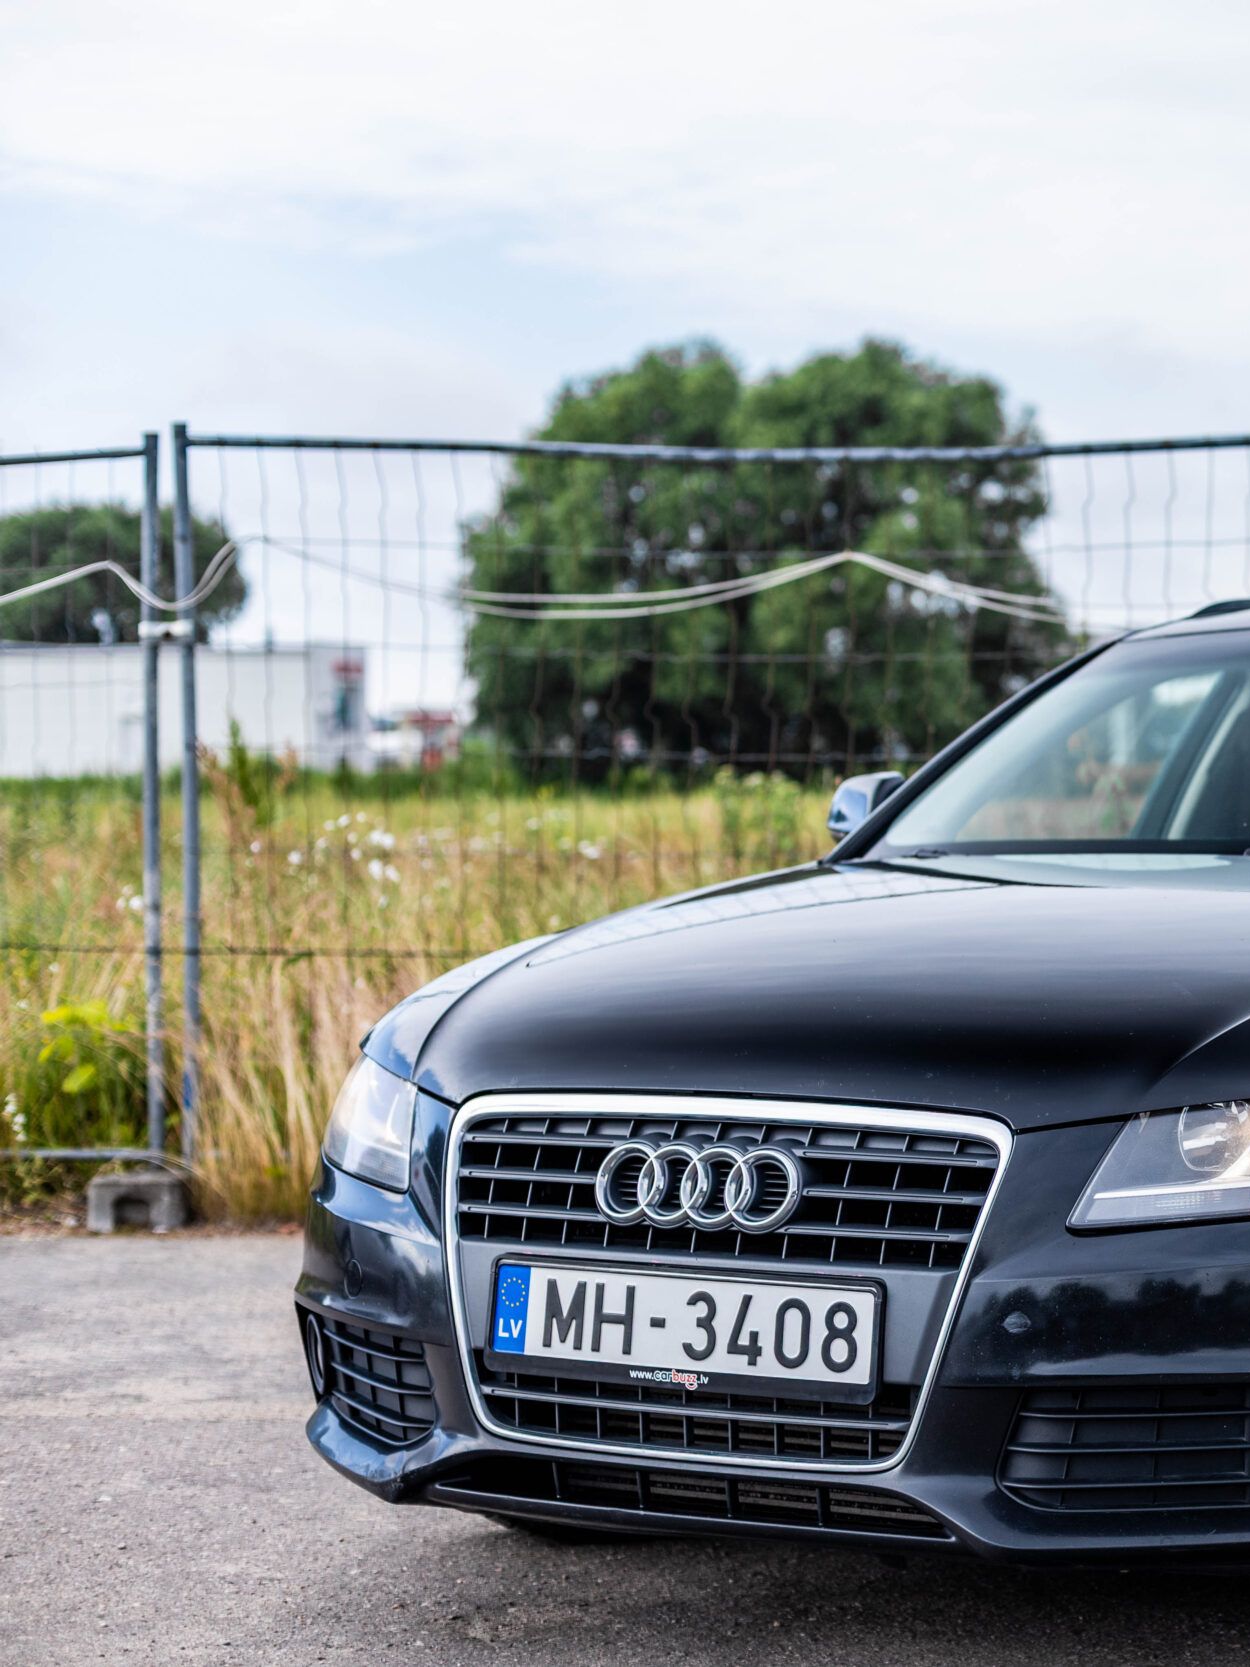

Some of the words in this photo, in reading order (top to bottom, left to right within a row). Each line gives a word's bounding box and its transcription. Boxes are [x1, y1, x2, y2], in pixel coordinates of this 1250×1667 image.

[498, 1318, 523, 1338] LV
[542, 1278, 858, 1373] MH-3408
[629, 1369, 709, 1385] www.carbuzz.lv
